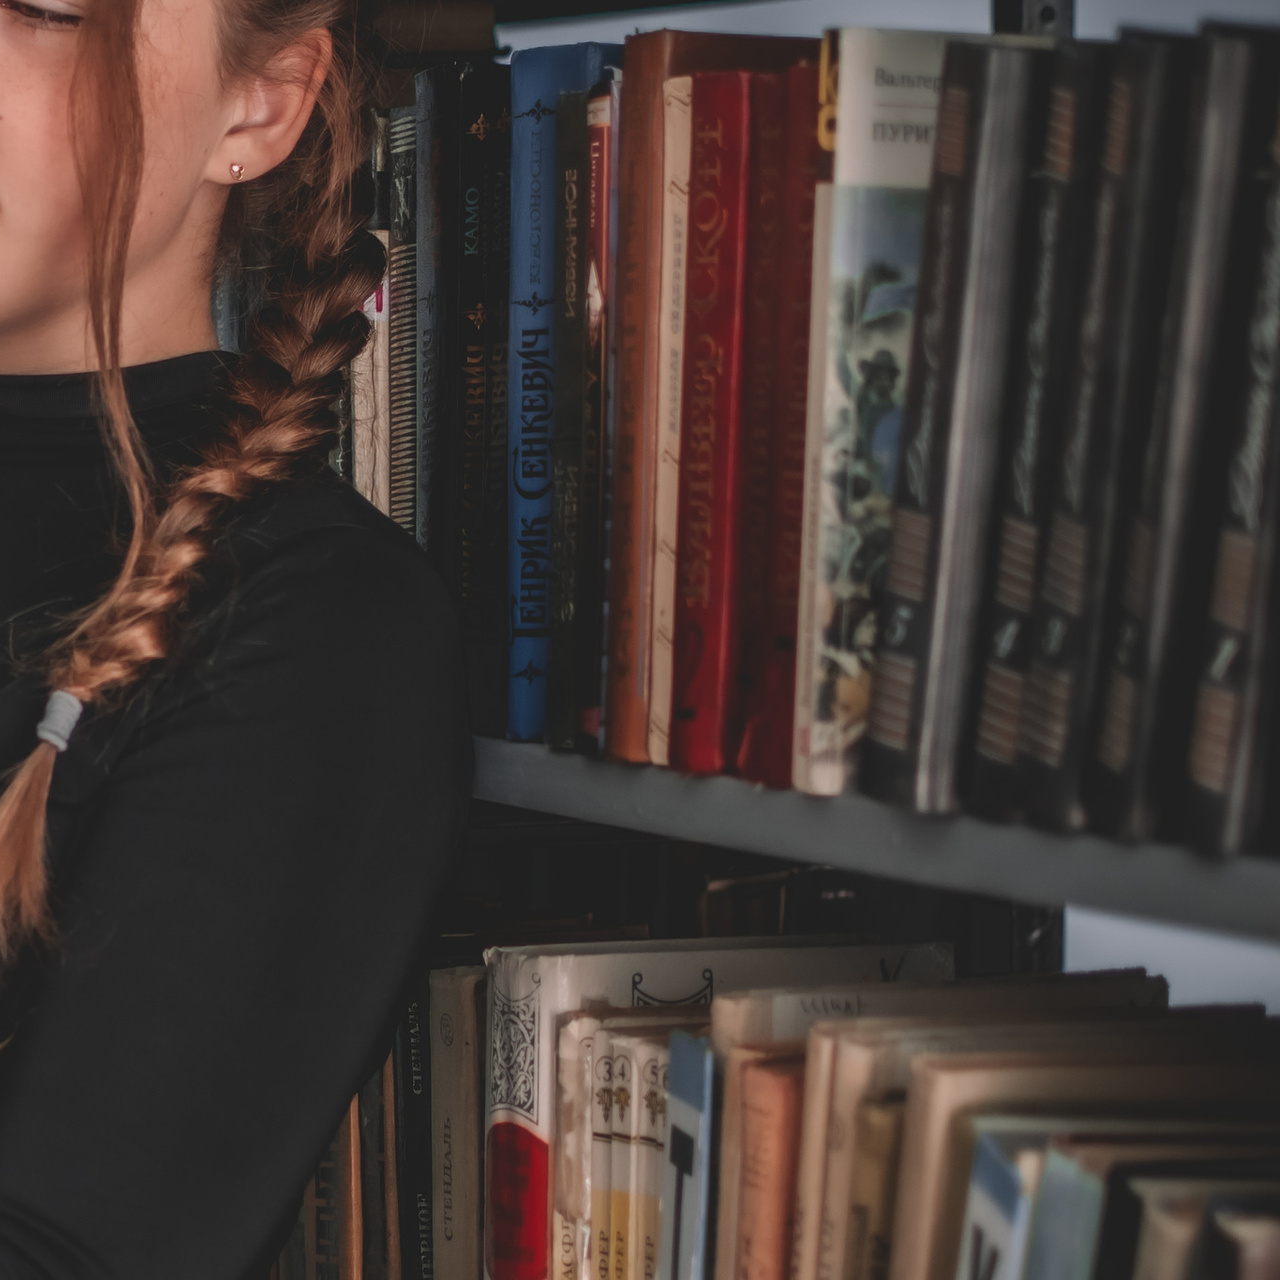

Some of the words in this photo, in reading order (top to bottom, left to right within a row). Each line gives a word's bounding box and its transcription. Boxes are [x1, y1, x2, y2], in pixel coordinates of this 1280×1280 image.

[464, 186, 480, 257] КАМО
[565, 169, 578, 318] ИЗБРАННОЕ
[688, 117, 728, 319] СКОТТ
[513, 327, 554, 501] СЕНКЕВИЧ
[509, 515, 552, 648] ГЕНРИК
[408, 1001, 423, 1097] СТЕНДАЛЬ
[602, 1060, 613, 1083] 3
[616, 1062, 626, 1081] 4
[441, 1116, 455, 1242] СТЕНДАЛЬ
